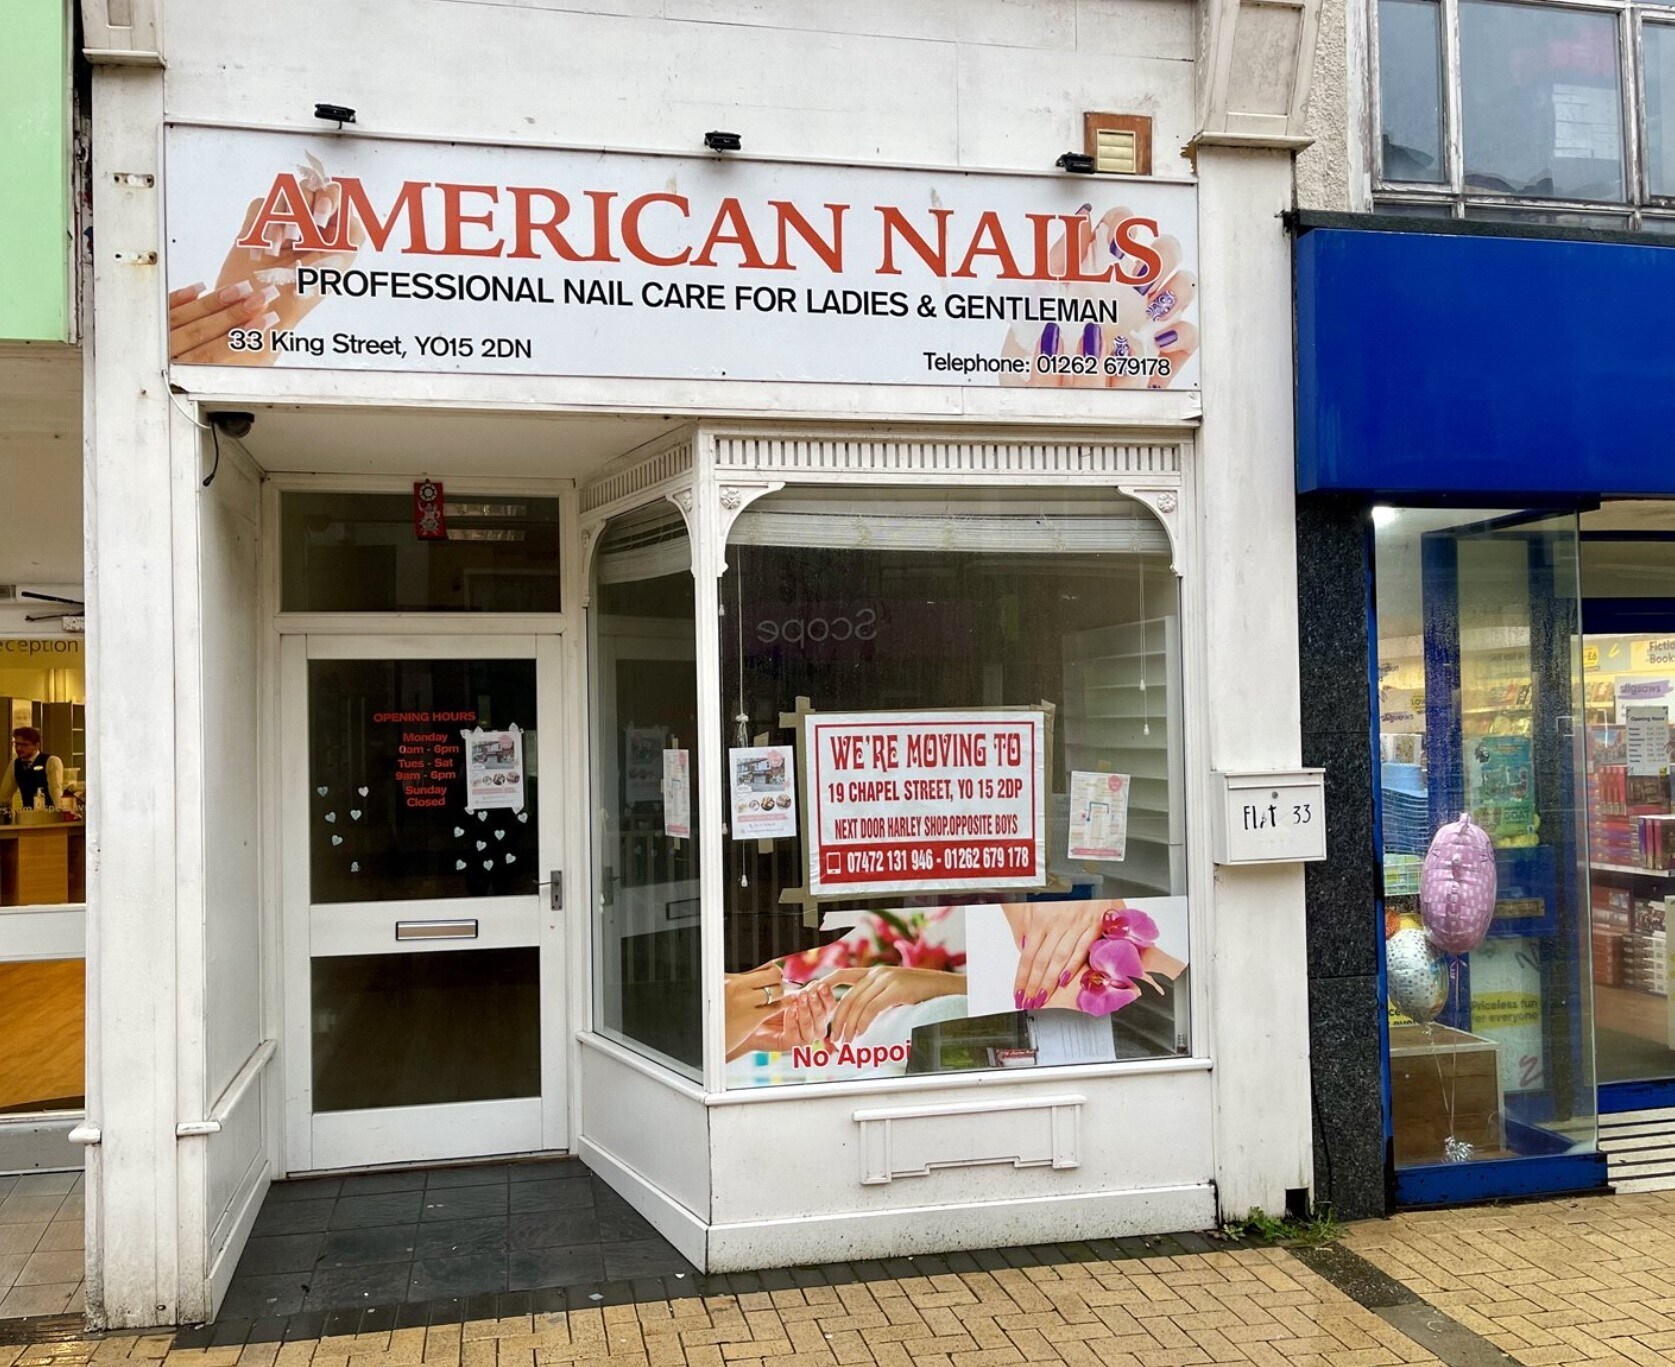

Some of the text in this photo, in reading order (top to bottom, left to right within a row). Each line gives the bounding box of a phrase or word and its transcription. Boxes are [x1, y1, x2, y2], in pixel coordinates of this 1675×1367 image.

[237, 172, 1162, 286] AMERICAN NAILS
[297, 267, 1118, 324] PROFESSIONAL NAIL CARE FOR LADIES & GENTLEMAN
[229, 330, 532, 359] 33 King Street, YO15 2DN
[923, 352, 1171, 377] Telephone: 01262 679178
[373, 711, 476, 723] OPENING HOURS
[402, 732, 448, 743] Monday
[433, 744, 460, 755] 6pm
[397, 759, 425, 768] Tues
[434, 758, 454, 767] Sat
[829, 732, 1021, 772] WE'RE MOVING TO
[395, 771, 421, 781] 9am
[430, 770, 457, 781] 6pm
[405, 785, 447, 795] Sunday
[406, 797, 446, 807] Closed
[828, 778, 1023, 803] 19 CHAPEL STREET, YO 15 2DP
[1292, 803, 1312, 824] 33
[834, 818, 859, 840] NEXT
[860, 817, 885, 839] DOOR
[887, 816, 921, 838] HARLEY
[995, 814, 1019, 835] BOYS
[846, 851, 884, 873] 07472
[887, 850, 908, 871] 131
[911, 849, 934, 870] 946
[944, 848, 980, 870] 01262
[983, 847, 1005, 868] 679
[1008, 846, 1029, 868] 178
[792, 1039, 912, 1069] No Appoi
